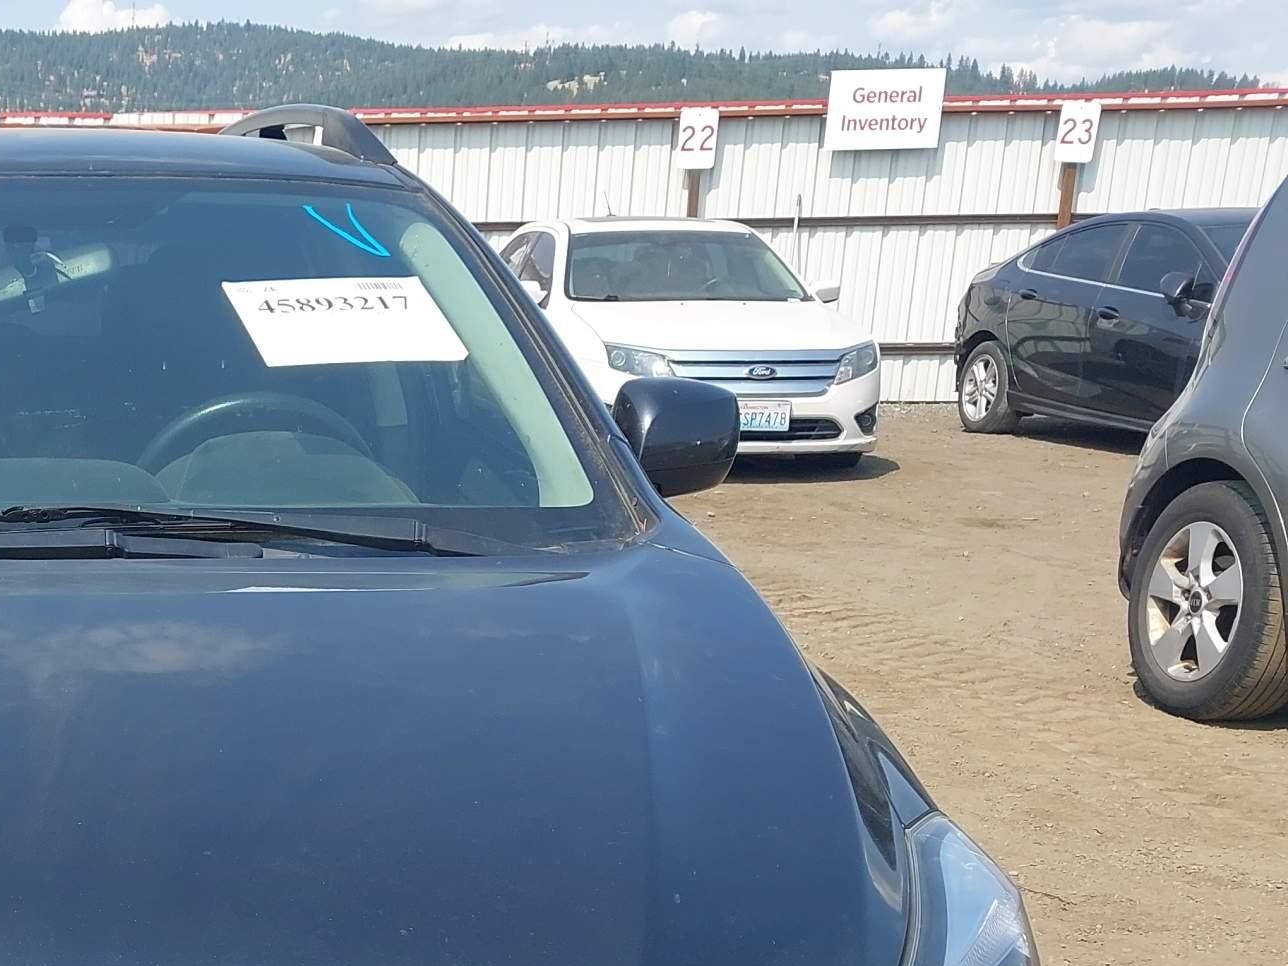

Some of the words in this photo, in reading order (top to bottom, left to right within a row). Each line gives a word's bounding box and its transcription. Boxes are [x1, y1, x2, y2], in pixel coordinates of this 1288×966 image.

[852, 85, 923, 104] General
[840, 114, 928, 134] Inventory
[1059, 117, 1094, 145] 23
[680, 125, 715, 152] 22
[258, 295, 408, 314] 45893217
[751, 366, 772, 376] Ford
[740, 411, 787, 427] SP7478
